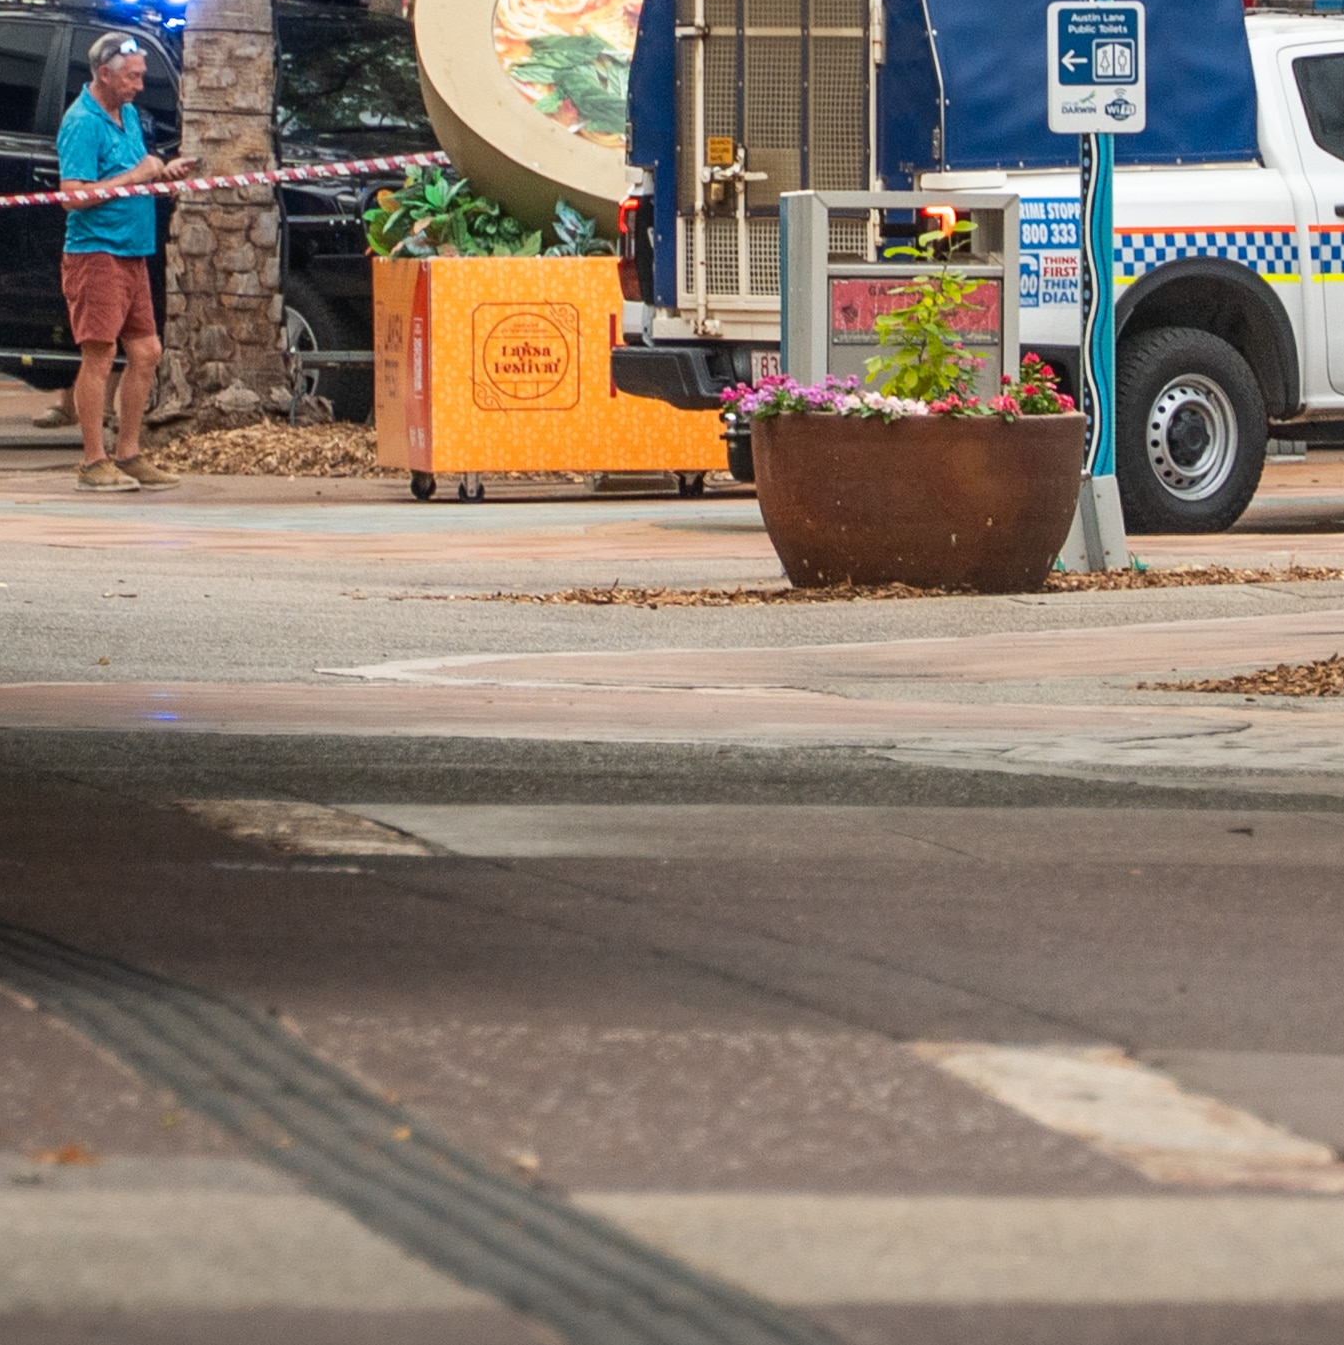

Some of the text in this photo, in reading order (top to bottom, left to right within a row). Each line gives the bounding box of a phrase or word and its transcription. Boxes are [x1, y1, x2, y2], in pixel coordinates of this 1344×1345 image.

[1071, 13, 1126, 22] Austin Lane
[1068, 24, 1128, 34] Public Toilets
[1021, 223, 1077, 244] 800 333
[1043, 256, 1077, 265] THINK
[1043, 266, 1078, 277] FIRST
[1043, 279, 1078, 289] THEN
[1042, 292, 1078, 303] DIAL
[494, 357, 561, 375] Festival
